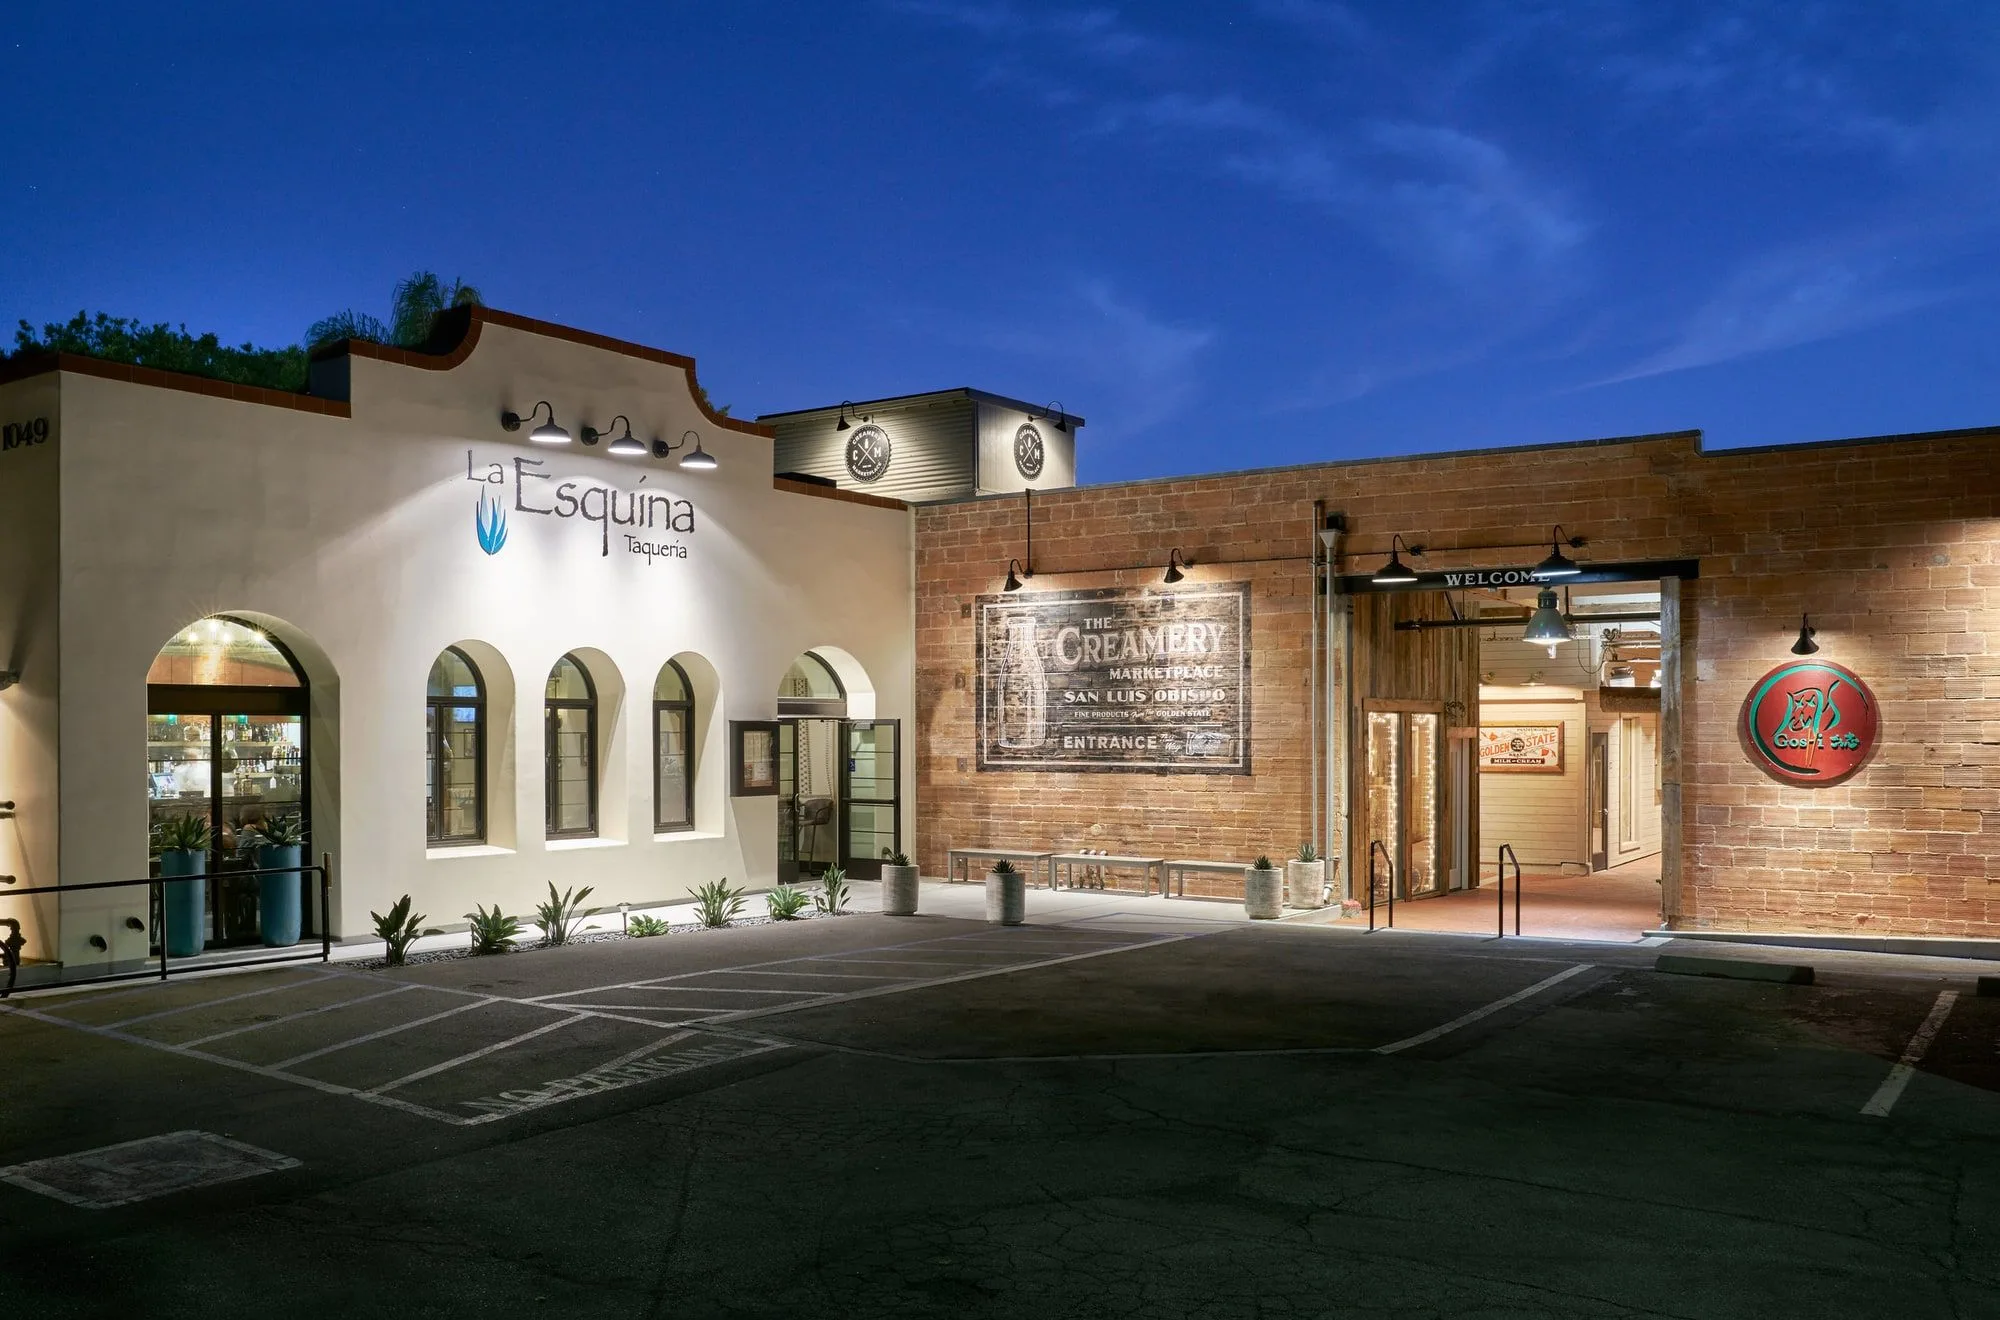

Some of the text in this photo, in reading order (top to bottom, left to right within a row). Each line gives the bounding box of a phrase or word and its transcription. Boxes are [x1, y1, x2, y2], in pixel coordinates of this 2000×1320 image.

[2, 418, 49, 451] 1049
[467, 449, 504, 484] La
[1083, 617, 1113, 630] THE
[1056, 622, 1227, 665] CREAMERY
[1109, 666, 1224, 681] MARKETPLACE
[1063, 688, 1226, 703] SAN LUIS OBISPO
[1091, 710, 1129, 718] PRODUCTS
[1156, 709, 1186, 717] GOLDEN
[1188, 709, 1211, 718] STATE
[1063, 735, 1157, 750] ENTRANCE
[1480, 742, 1510, 758] GOLDEN
[1526, 732, 1556, 748] STATE
